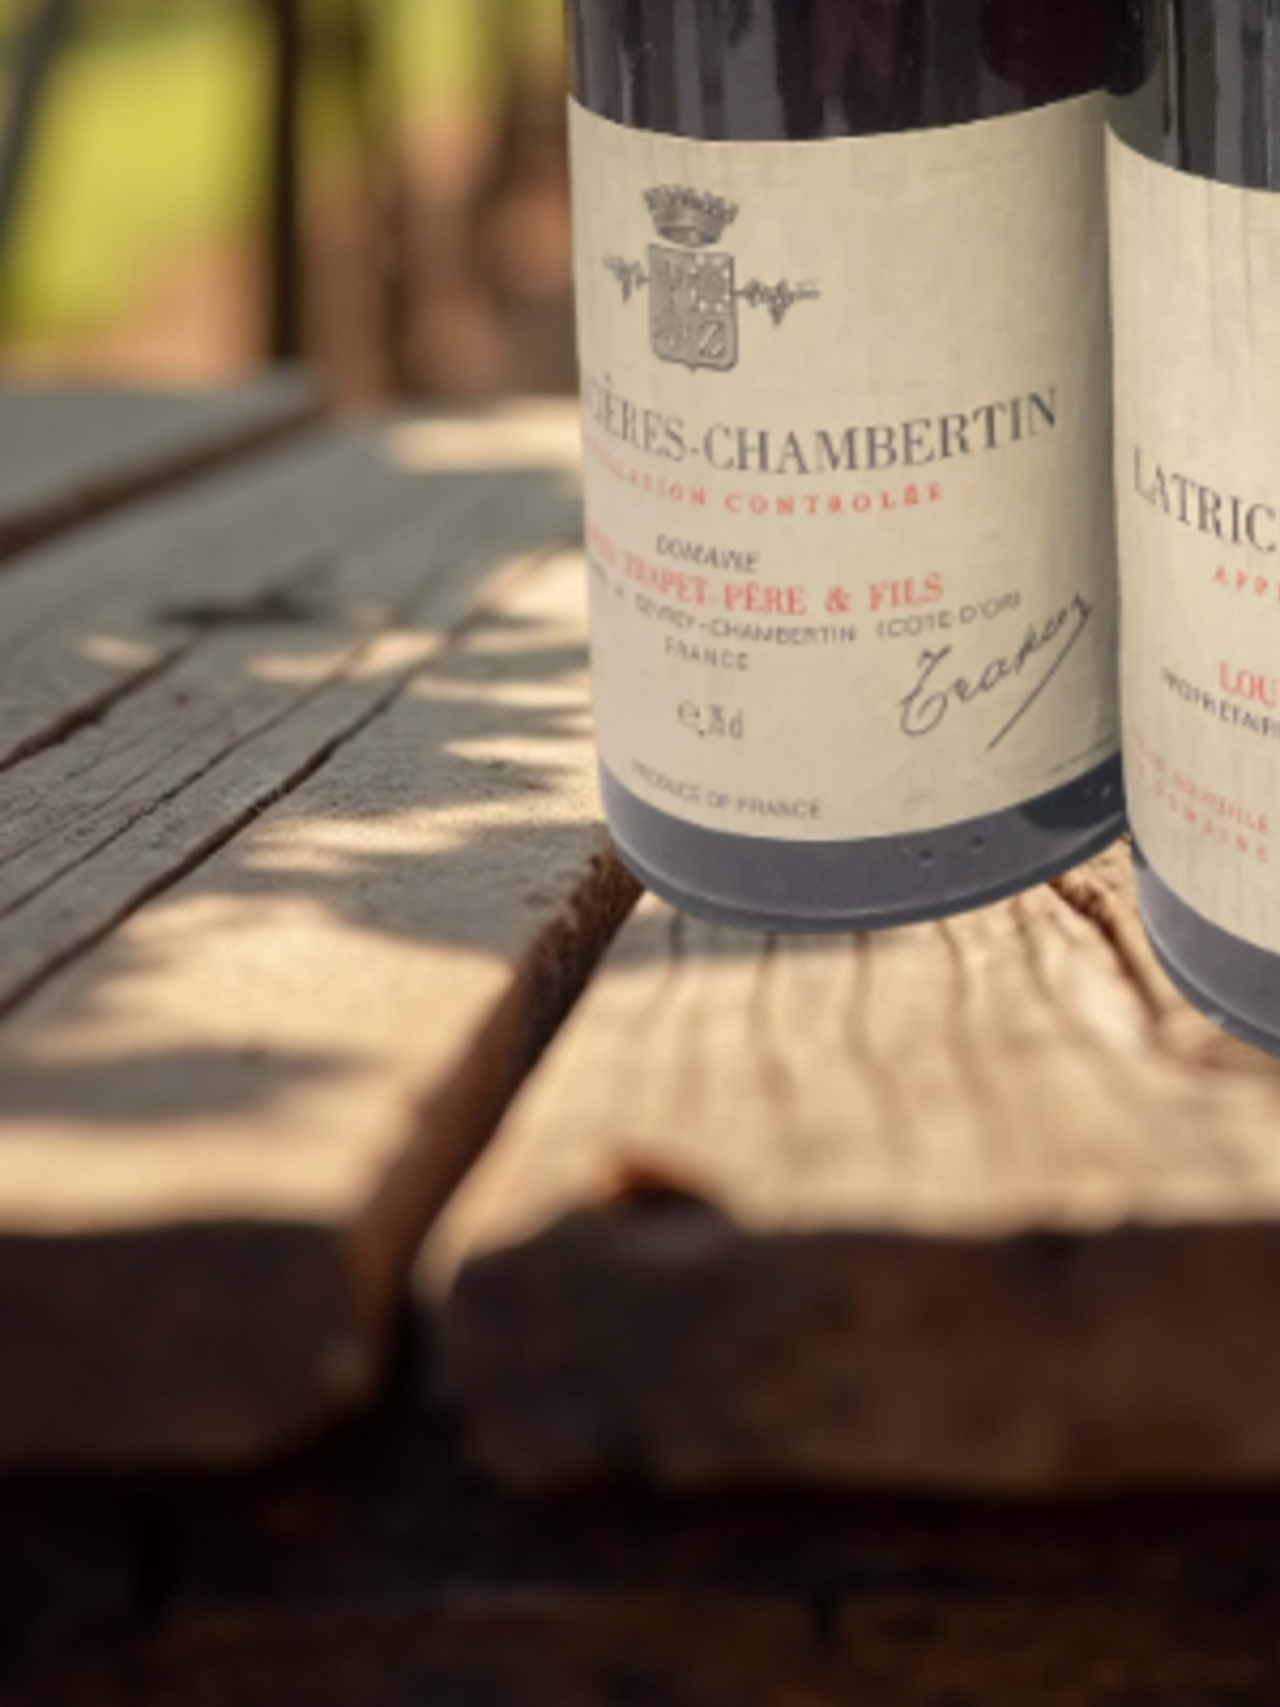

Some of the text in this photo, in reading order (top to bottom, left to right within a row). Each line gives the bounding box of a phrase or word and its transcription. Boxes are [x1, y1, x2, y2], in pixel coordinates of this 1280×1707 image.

[656, 532, 759, 573] DOMAINE
[624, 549, 709, 606] TRAPET
[824, 584, 852, 613] &
[867, 570, 945, 611] FILS
[664, 635, 749, 671] FRANCE
[630, 758, 823, 820] PRODUCE OF FRANCE
